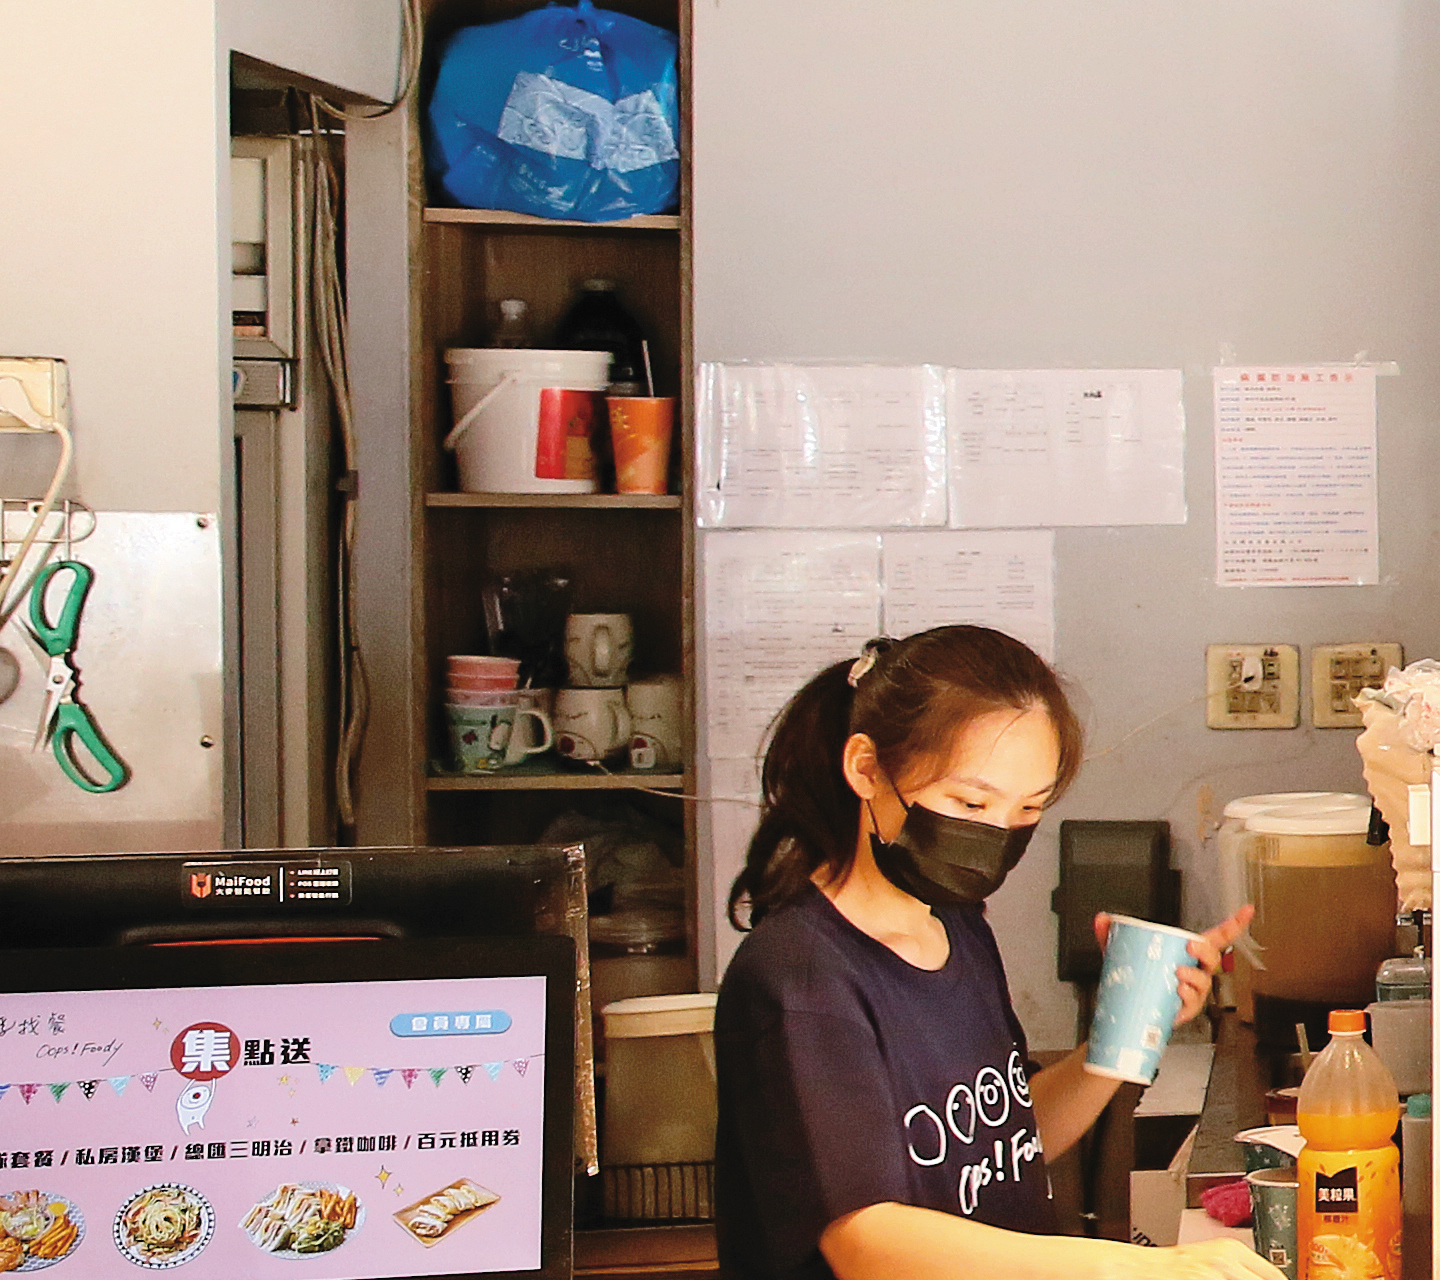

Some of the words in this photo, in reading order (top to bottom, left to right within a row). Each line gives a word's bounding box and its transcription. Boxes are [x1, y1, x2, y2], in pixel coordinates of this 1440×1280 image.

[214, 876, 271, 887] MaiFood
[80, 1038, 124, 1067] Foody
[181, 1029, 311, 1072] 集點送
[1318, 1187, 1356, 1202] 美粒果
